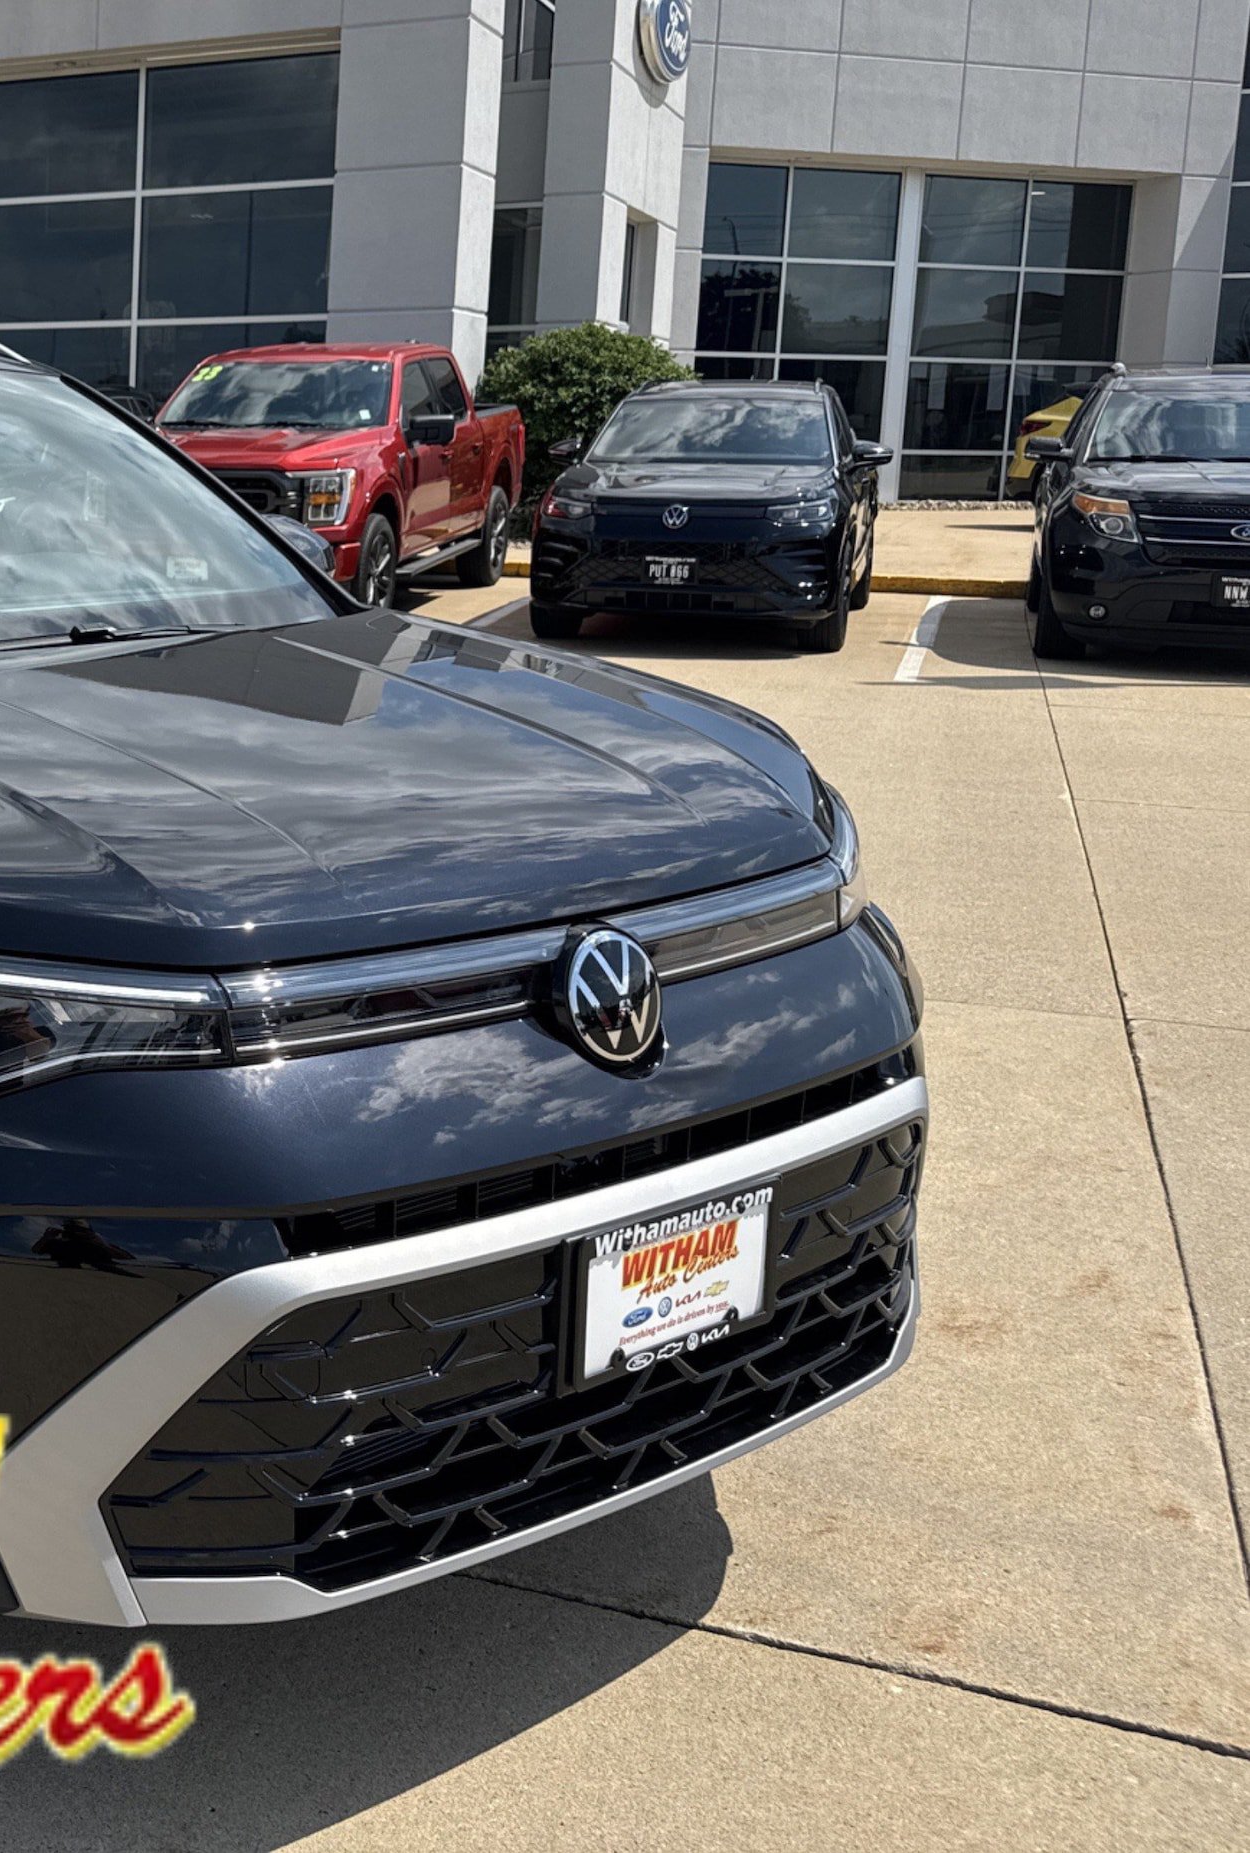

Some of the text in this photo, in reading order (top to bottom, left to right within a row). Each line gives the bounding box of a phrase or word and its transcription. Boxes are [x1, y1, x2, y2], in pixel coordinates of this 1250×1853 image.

[664, 1, 689, 63] Ford
[595, 1187, 773, 1258] Withamauto.com
[621, 1218, 739, 1289] WITHAM
[637, 1243, 740, 1304] Auto Centers
